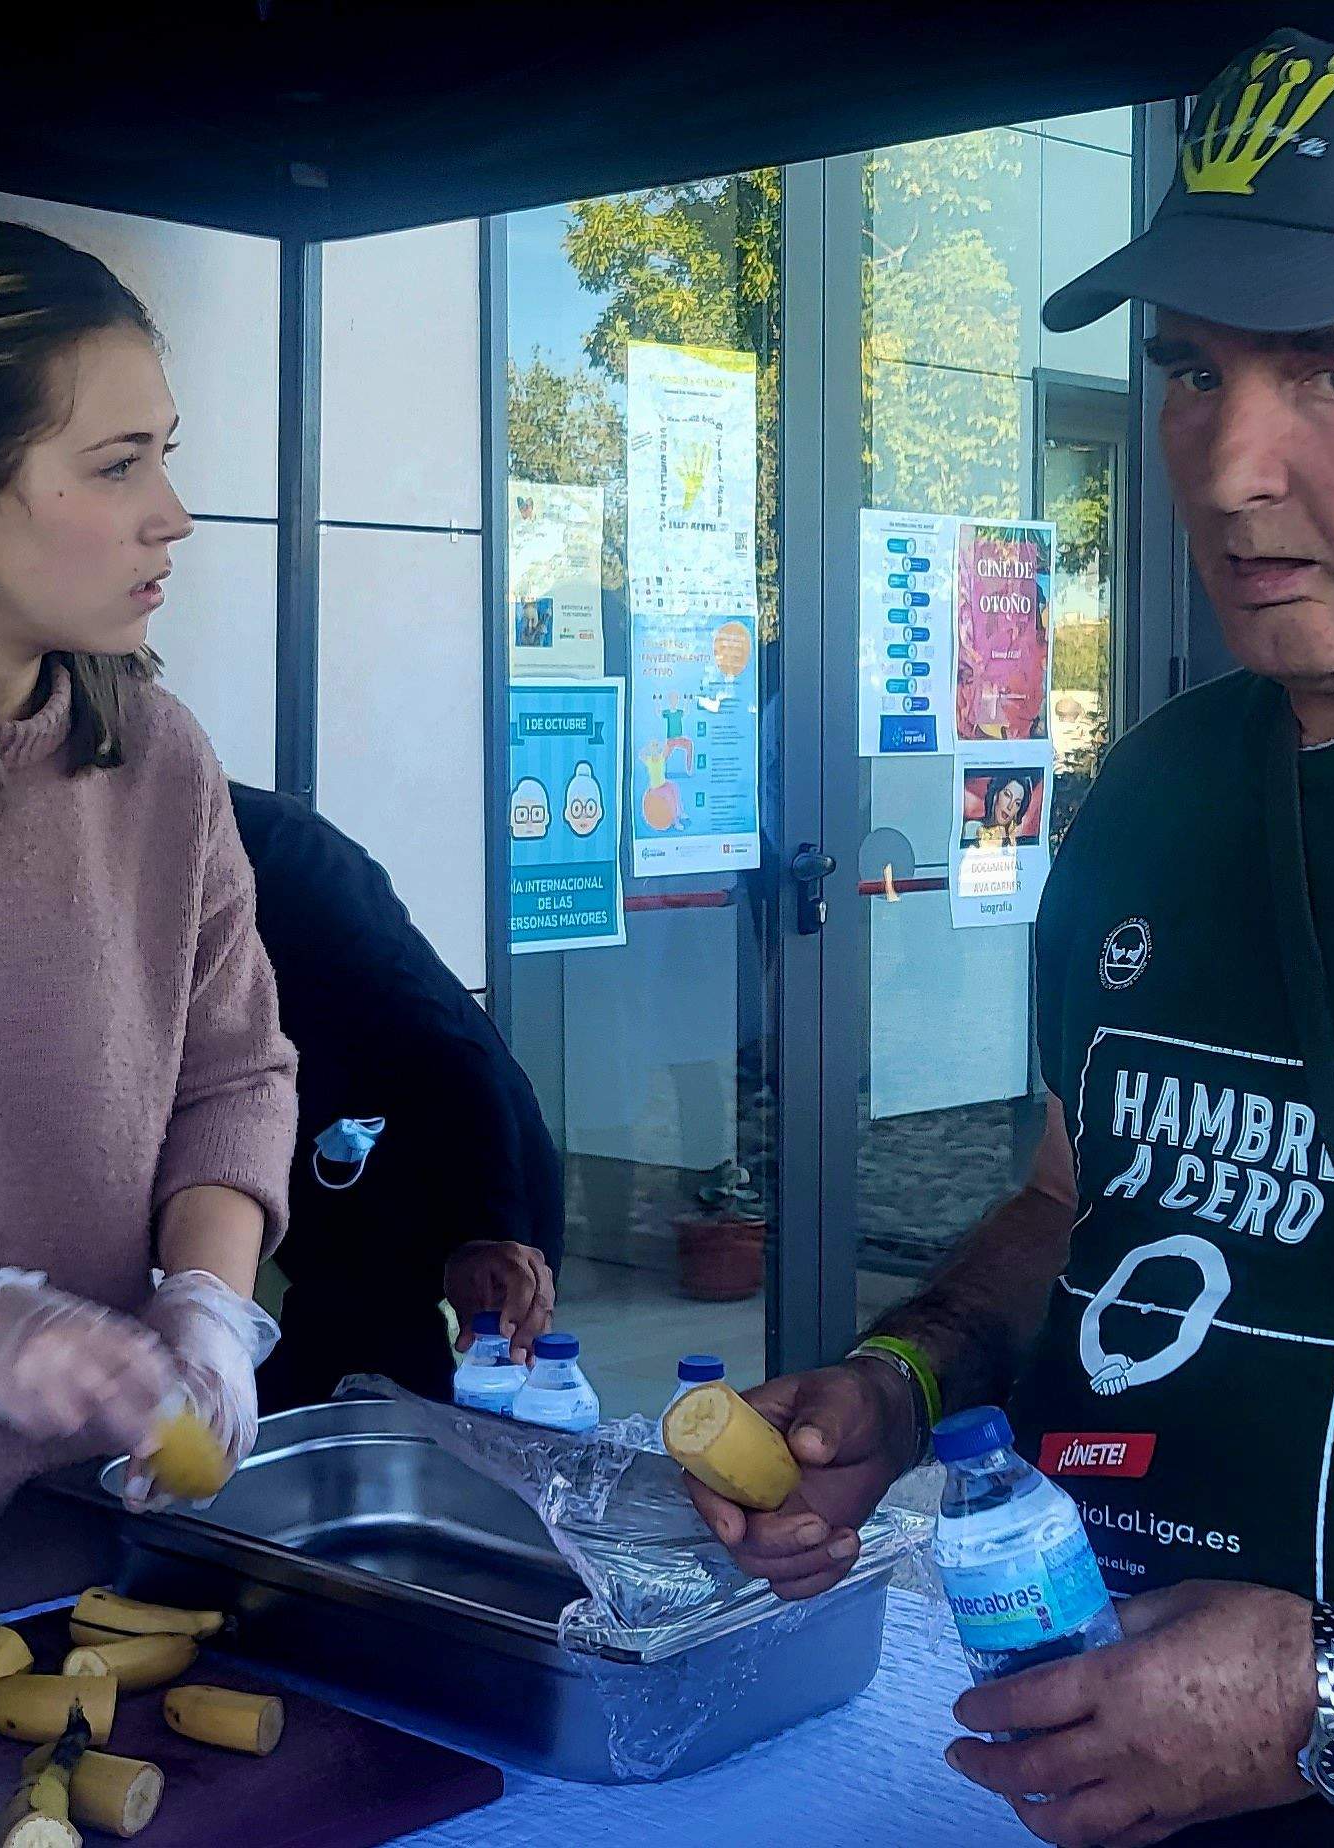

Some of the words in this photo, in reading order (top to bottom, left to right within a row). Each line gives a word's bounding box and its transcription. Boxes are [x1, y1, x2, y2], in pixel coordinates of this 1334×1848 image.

[977, 559, 1012, 579] CINE
[1015, 561, 1034, 580] DE
[979, 593, 1031, 615] OTOÑO
[531, 718, 544, 731] DE
[545, 717, 587, 731] OCTUBRE
[510, 878, 524, 895] ÍA
[525, 874, 604, 893] INTERNACIONAL
[538, 897, 553, 911] DE
[554, 896, 573, 910] LAS
[510, 913, 558, 932] ERSONAS
[559, 909, 608, 928] MAYORES
[1103, 1145, 1153, 1198] A
[1159, 1153, 1325, 1245] CERO
[1057, 1439, 1128, 1473] ¡ÚNETE!
[1076, 1501, 1242, 1554] ioLaLiga.es
